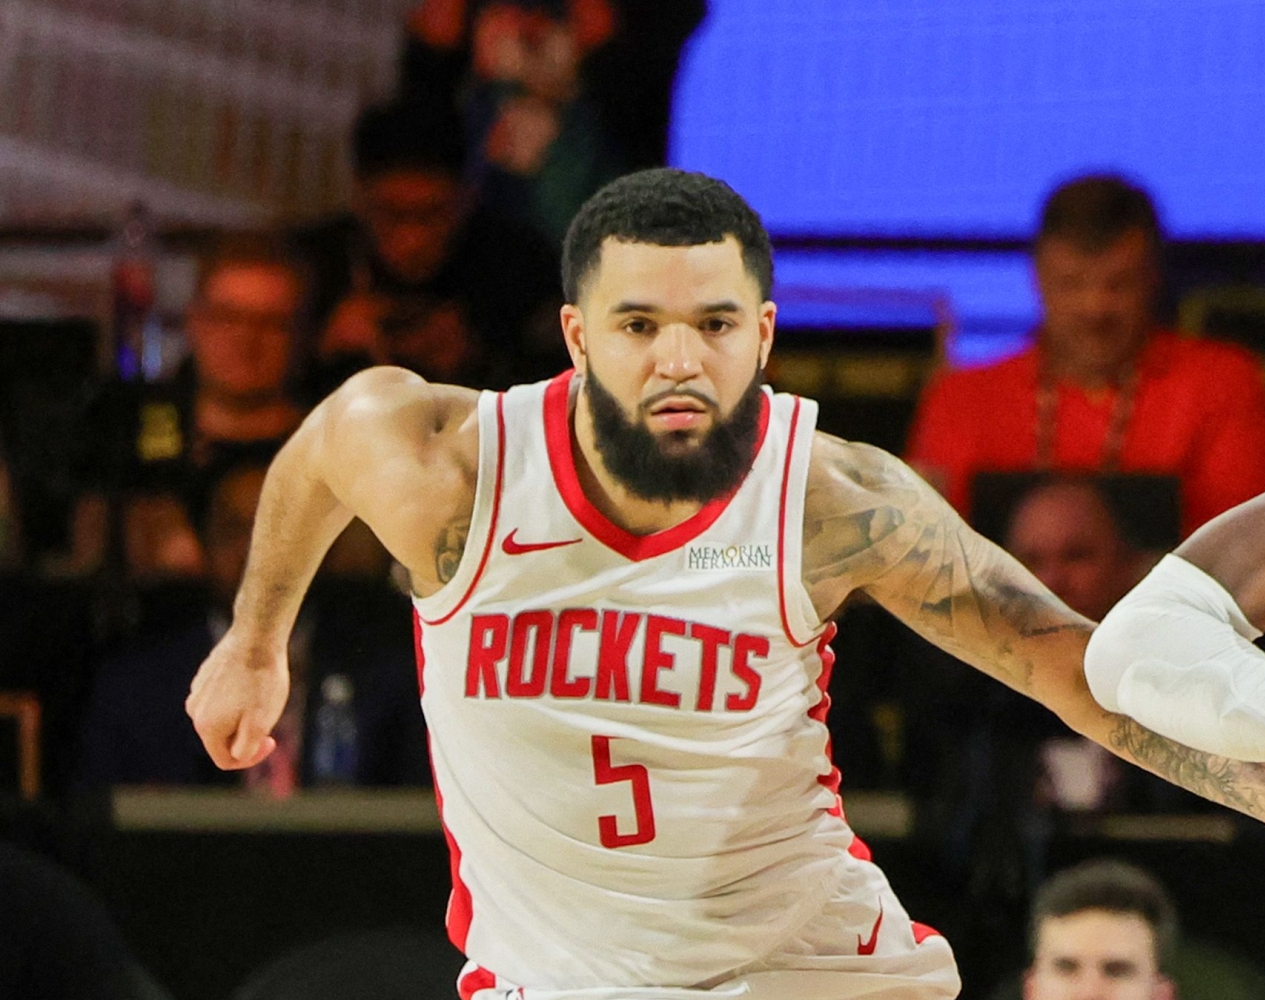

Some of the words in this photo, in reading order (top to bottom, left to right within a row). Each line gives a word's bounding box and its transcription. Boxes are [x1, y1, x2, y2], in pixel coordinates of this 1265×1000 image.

[688, 553, 771, 569] HERMANN
[690, 545, 772, 560] MEMORIAL
[464, 608, 770, 713] ROCKETS
[591, 734, 656, 849] 5
